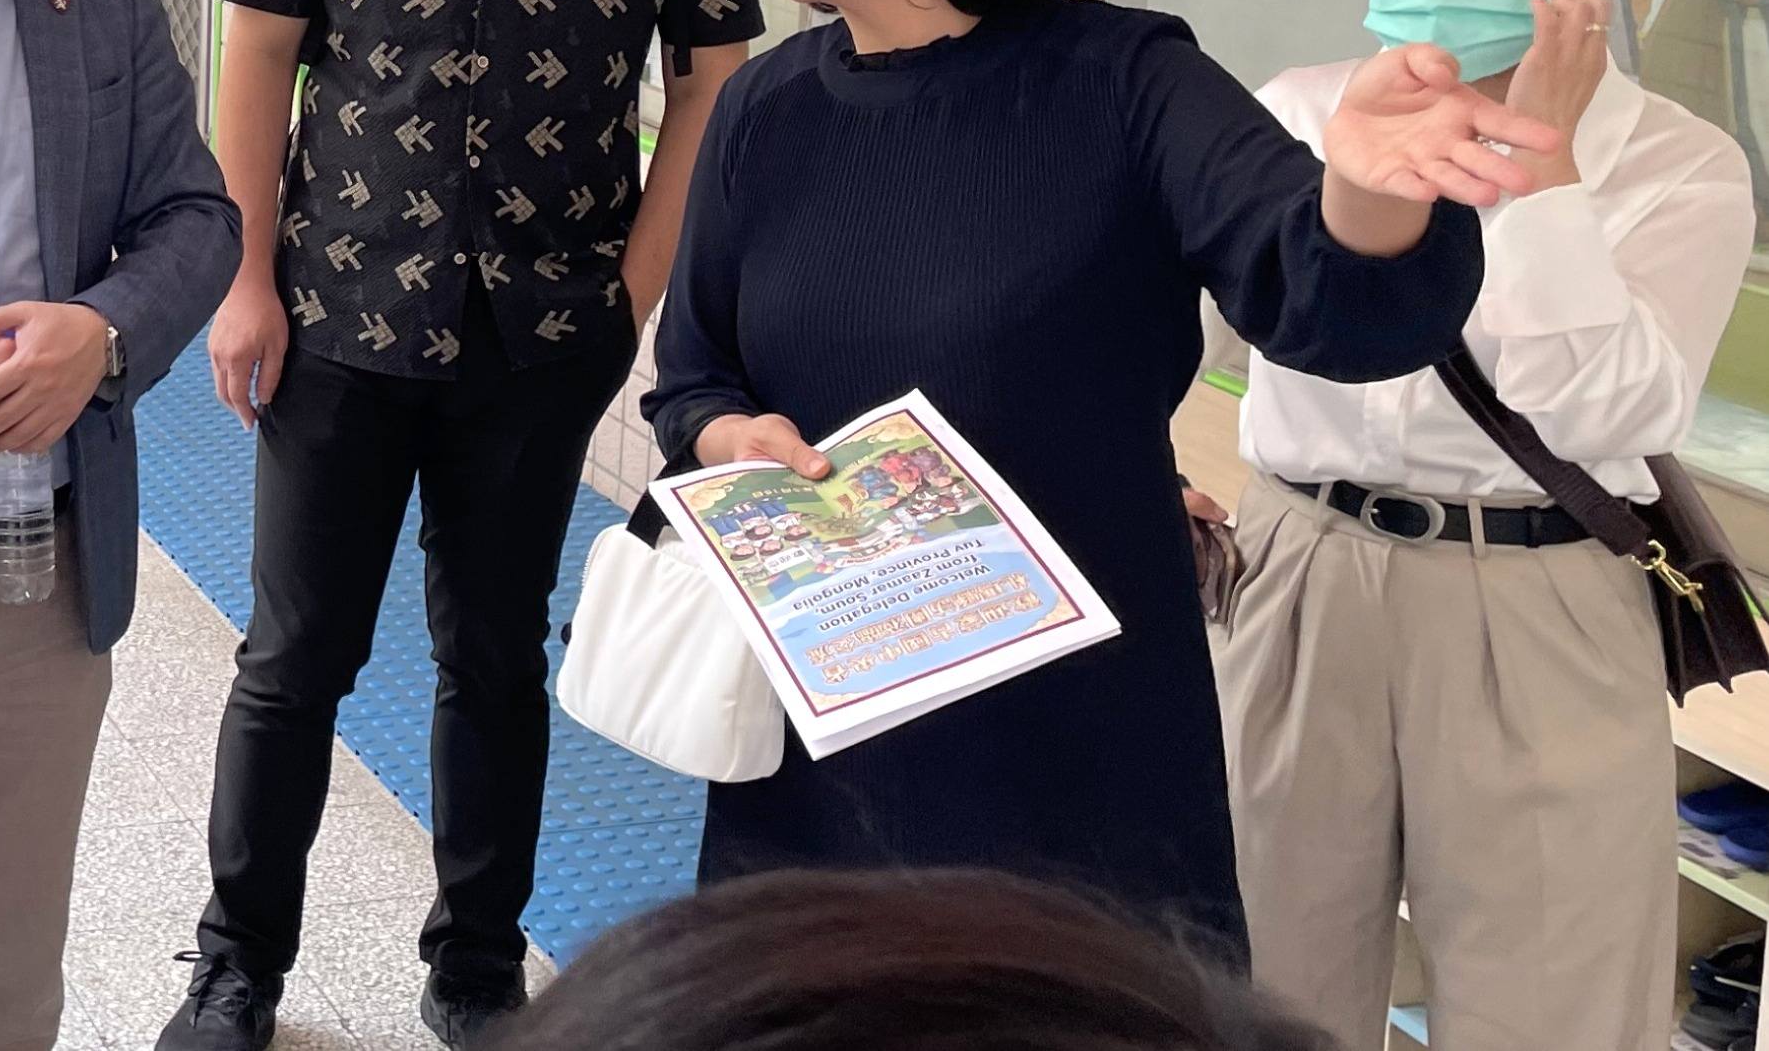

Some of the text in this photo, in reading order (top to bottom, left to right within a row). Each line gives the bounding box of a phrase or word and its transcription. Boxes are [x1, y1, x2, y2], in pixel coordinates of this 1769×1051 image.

[793, 539, 983, 610] Tuv Province, Mongolia
[815, 554, 978, 615] from Zaamar Soum,
[819, 565, 991, 631] Welcome Delegation
